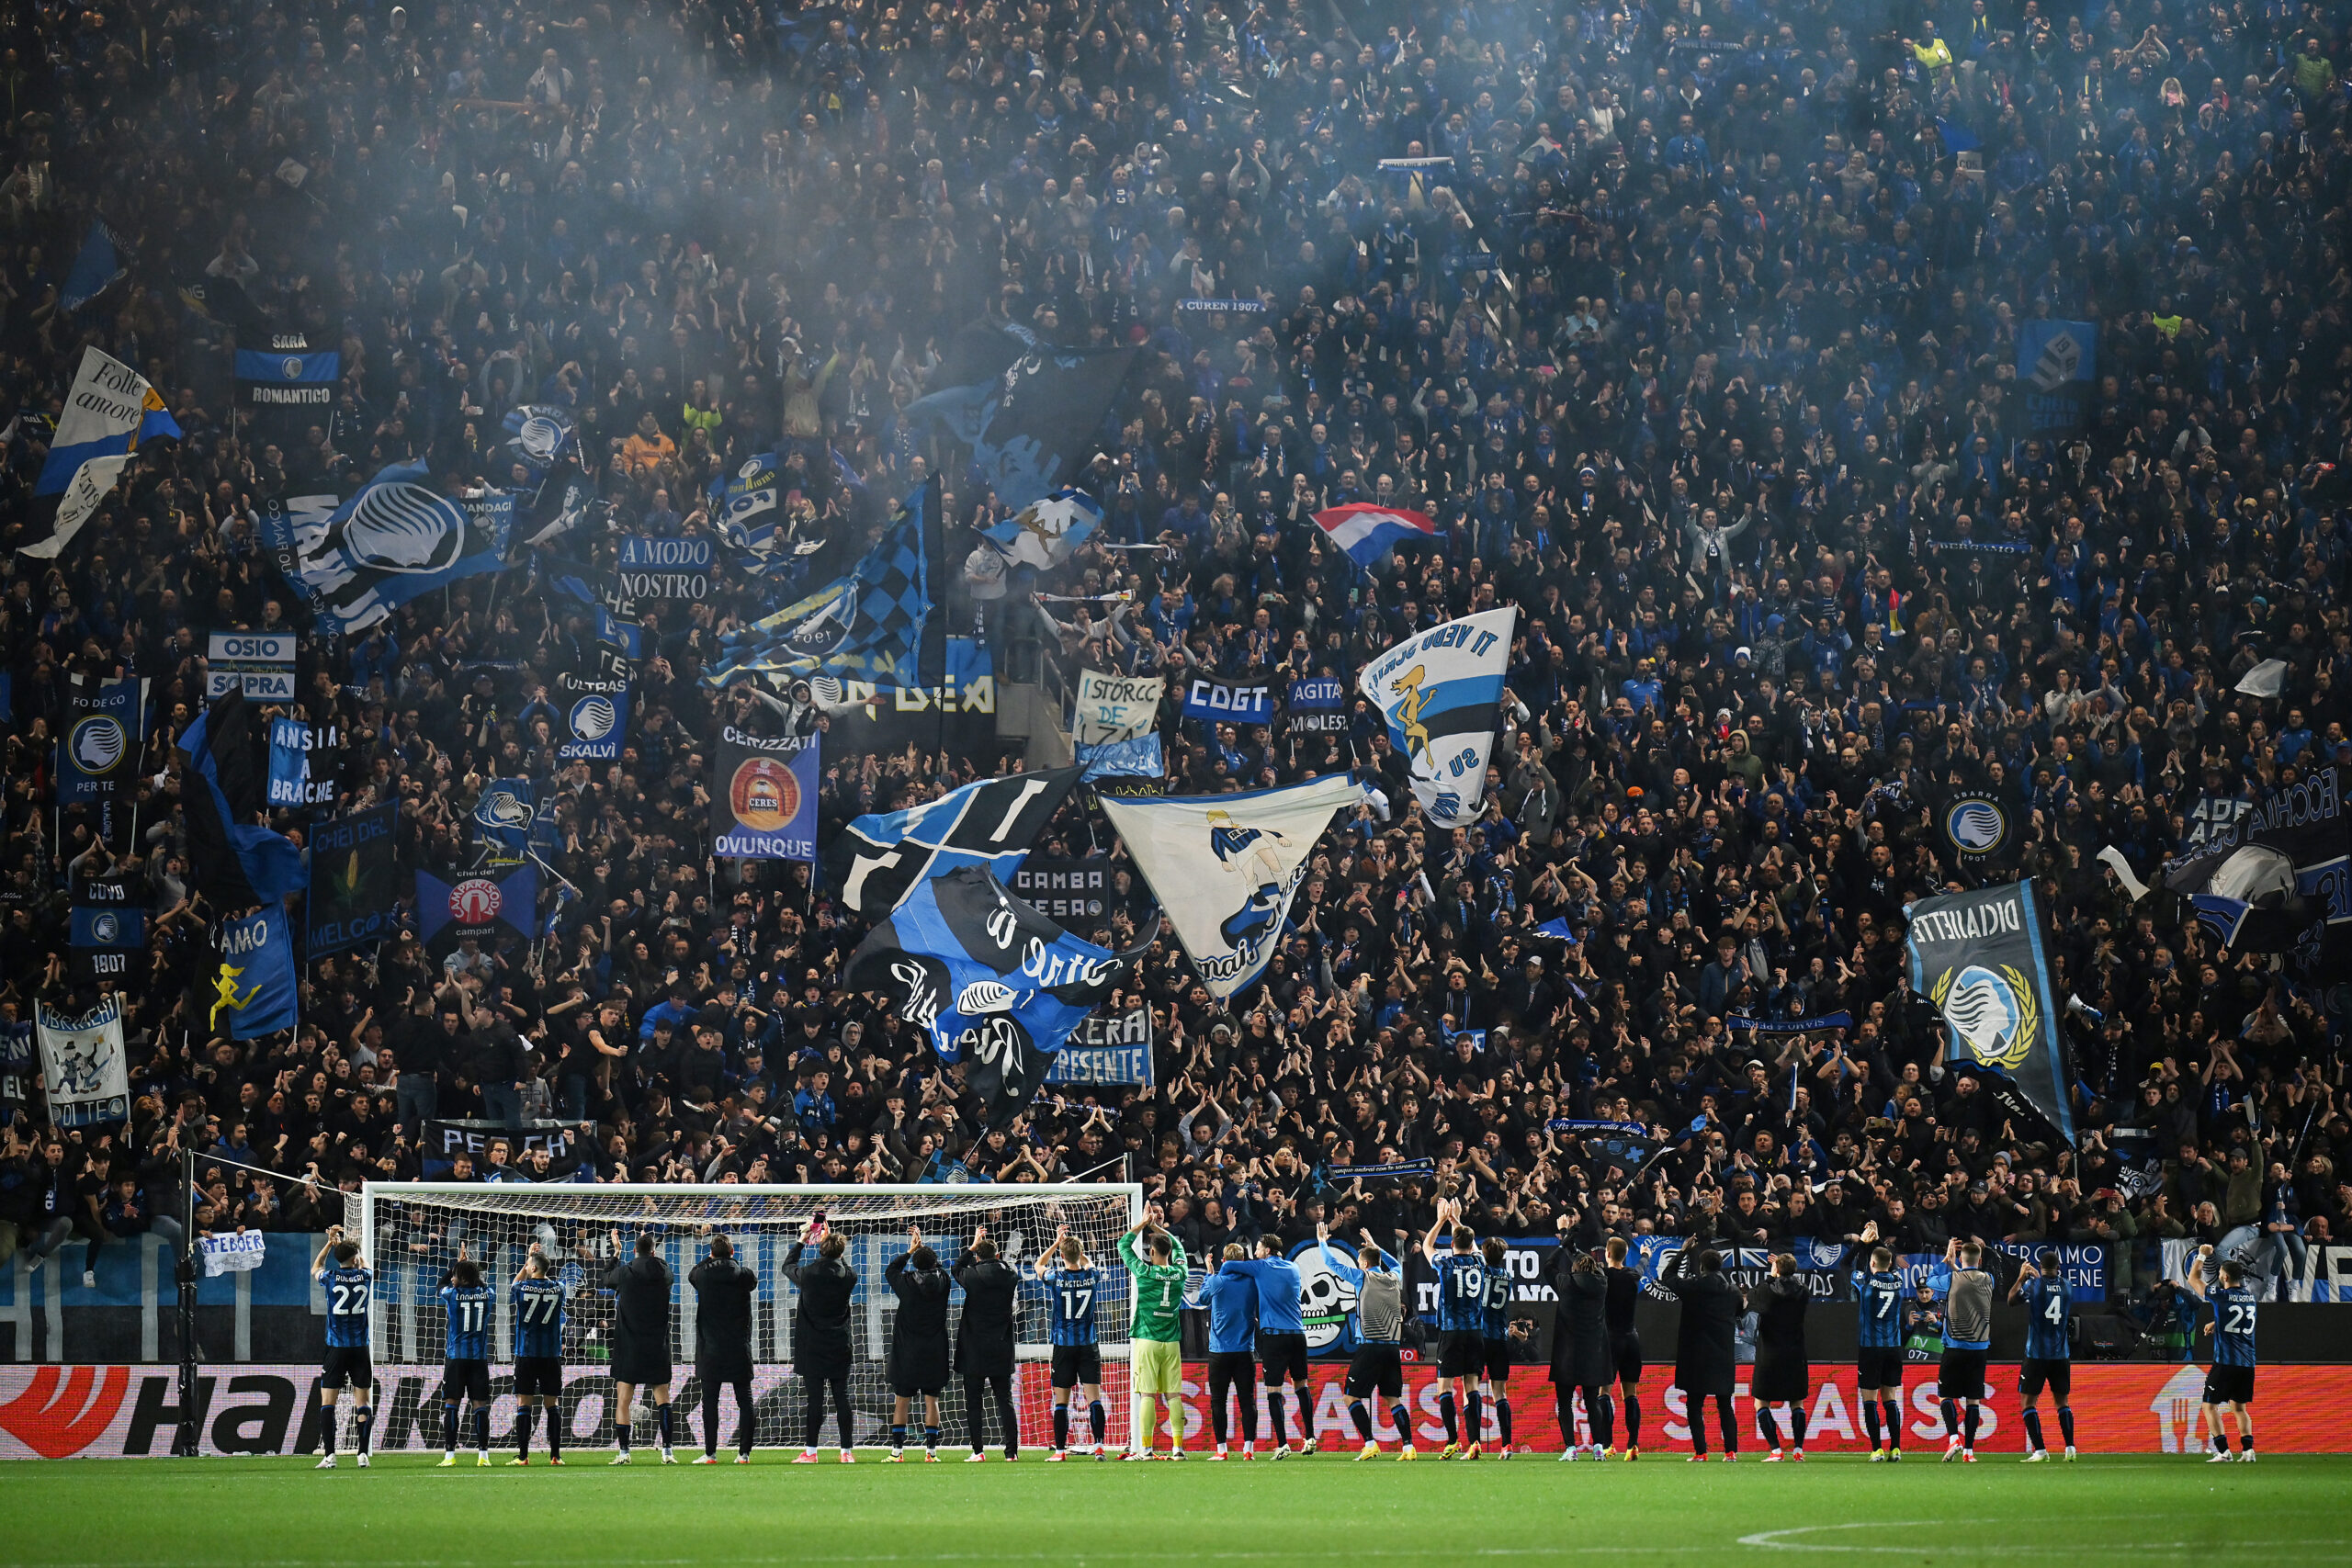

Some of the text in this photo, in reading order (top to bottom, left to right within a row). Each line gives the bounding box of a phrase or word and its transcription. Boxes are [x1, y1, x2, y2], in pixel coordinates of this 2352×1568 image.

[1186, 301, 1258, 312] CUREN 1907
[272, 333, 307, 348] SARÀ
[89, 362, 141, 397] Folle
[252, 387, 331, 403] ROMANTICO
[75, 391, 141, 424] amore
[623, 539, 709, 565] A MODO
[1940, 543, 2015, 554] BERGAMO
[620, 572, 707, 599] NOSTRO
[224, 639, 279, 656] OSIO
[212, 675, 288, 694] SOPRA
[567, 677, 627, 693] ULTRAS
[74, 694, 125, 707] FO DE CO
[1097, 705, 1128, 727] DE
[276, 726, 337, 751] ANSIA
[560, 744, 616, 758] SKALVÌ
[300, 759, 311, 779] A
[76, 780, 115, 793] PER TE
[271, 779, 334, 805] BRACHE
[1953, 791, 1999, 802] SBARRA
[749, 797, 777, 807] CERES
[715, 835, 813, 858] OVUNQUE
[1017, 871, 1102, 888] GAMBA
[88, 883, 125, 900] COVO
[456, 927, 494, 937] campari
[92, 953, 126, 974] 1907
[40, 998, 119, 1031] UBRIACHI
[62, 1099, 107, 1125] DI TE
[1571, 1122, 1597, 1132] sempre
[1620, 1124, 1641, 1135] storia
[1159, 1281, 1170, 1307] 1
[1453, 1269, 1482, 1298] 19
[1482, 1277, 1509, 1310] 15
[332, 1285, 368, 1314] 22
[523, 1293, 560, 1325] 77
[1061, 1290, 1092, 1319] 17
[1877, 1292, 1894, 1318] 7
[2044, 1295, 2063, 1325] 4
[459, 1302, 484, 1332] 11
[2224, 1304, 2256, 1335] 23
[1911, 1335, 1928, 1348] TV
[1907, 1348, 1929, 1360] 077
